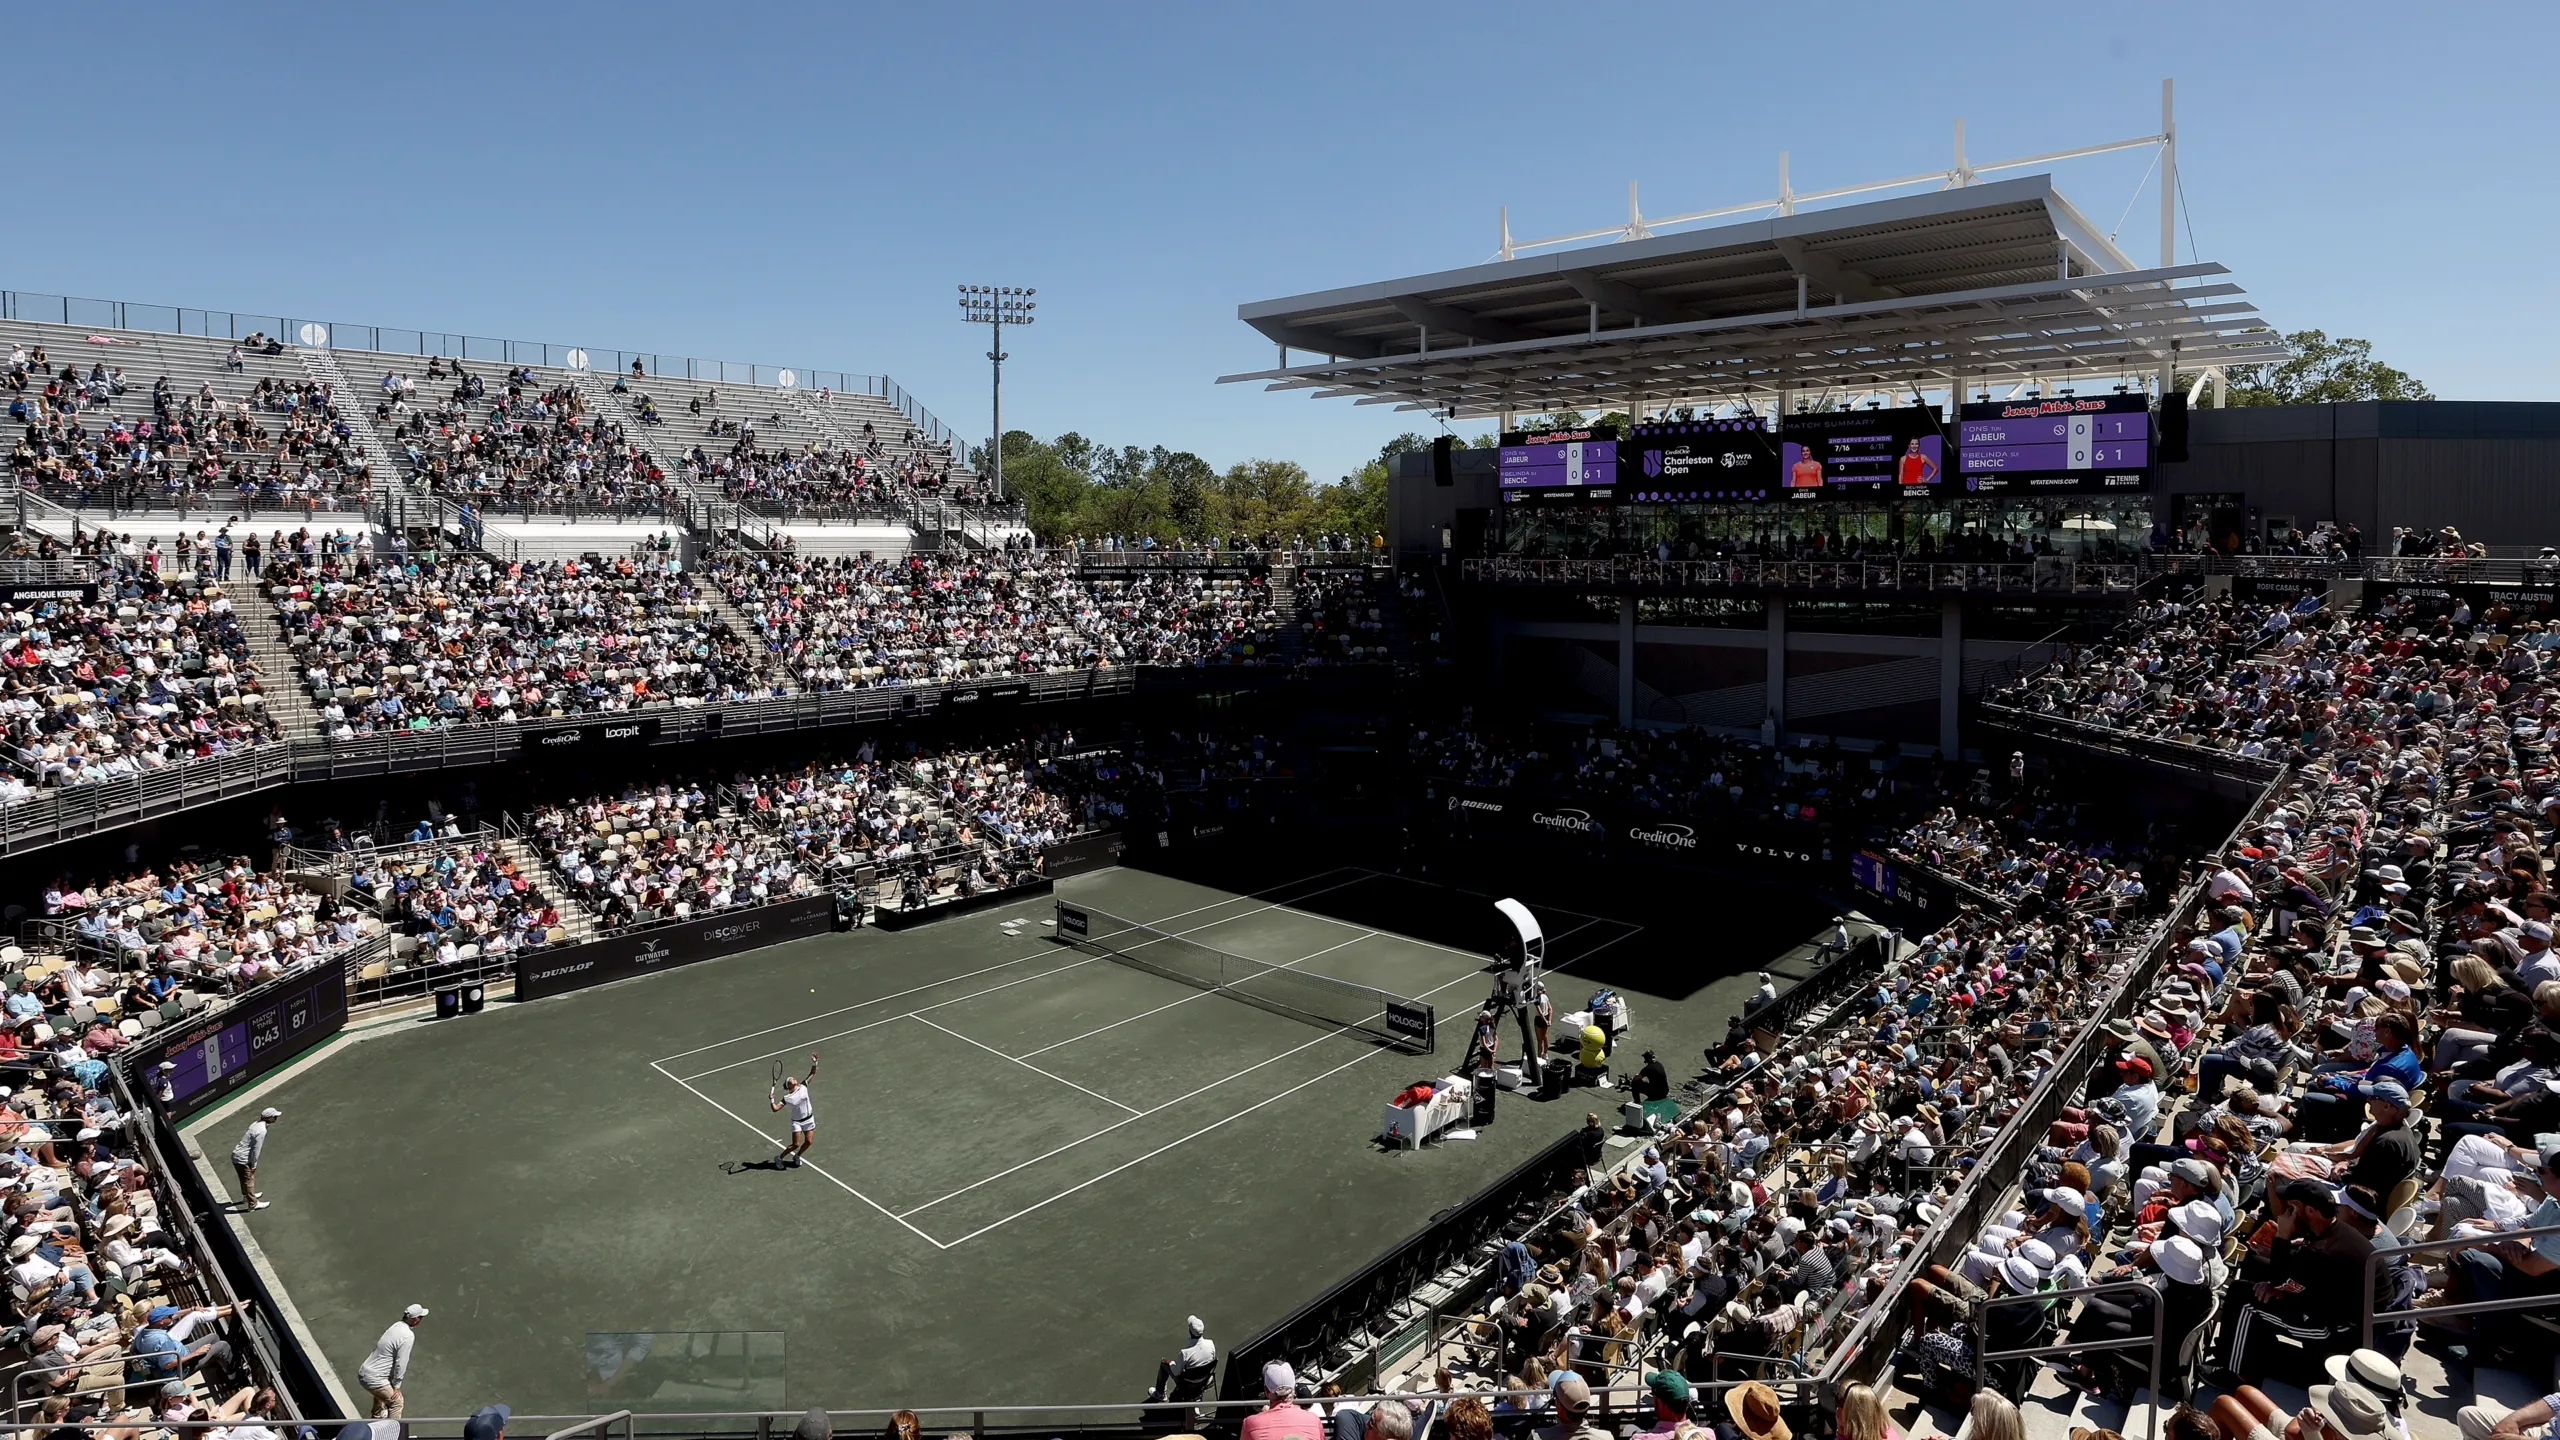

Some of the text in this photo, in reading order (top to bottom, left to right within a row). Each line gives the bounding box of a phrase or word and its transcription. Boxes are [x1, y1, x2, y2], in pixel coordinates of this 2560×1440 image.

[2002, 406, 2038, 418] Jersey
[1824, 419, 1876, 428] SUMMARY
[2075, 424, 2085, 434] 0
[2097, 423, 2103, 434] 1
[2116, 422, 2122, 433] 1
[1969, 433, 2006, 442] JABEUR
[1571, 449, 1578, 459] 0
[1585, 449, 1589, 457] 1
[1596, 448, 1601, 457] 1
[2074, 450, 2084, 461] 0
[2095, 449, 2104, 461] 6
[2115, 449, 2122, 460] 1
[1504, 456, 1529, 464] JABEUR
[1664, 455, 1714, 466] Charleston
[1968, 459, 2004, 468] BENCIC
[1571, 470, 1578, 480] 0
[1583, 470, 1590, 479] 6
[1596, 469, 1601, 478] 1
[1664, 465, 1689, 476] Open
[1837, 483, 1846, 491] 28
[1872, 482, 1880, 490] 41
[1903, 489, 1930, 497] BENCIC
[2257, 583, 2300, 592] ROSIE CASALS
[2397, 588, 2420, 596] CHRIS
[13, 590, 84, 600] ANGELIQUE KERBER
[2489, 591, 2554, 603] TRACY AUSTIN
[1461, 799, 1503, 812] BOEING
[1533, 812, 1590, 832] CreditOne
[1630, 828, 1696, 848] CreditOne
[1736, 843, 1810, 861] VOLVO
[1918, 897, 1927, 909] 87
[1063, 915, 1085, 928] HOLOGIC
[703, 920, 760, 941] DISCOVER
[635, 949, 669, 963] CUTWATER
[540, 961, 594, 979] DUNLOP
[290, 997, 306, 1009] MPH
[252, 1009, 276, 1026] MATCH
[292, 1009, 307, 1029] 87
[1388, 1012, 1423, 1030] HOLOGIC
[256, 1017, 273, 1030] TIME
[229, 1034, 234, 1043] 1
[252, 1025, 280, 1050] 0:43
[221, 1059, 227, 1069] 6
[231, 1054, 236, 1063] 1
